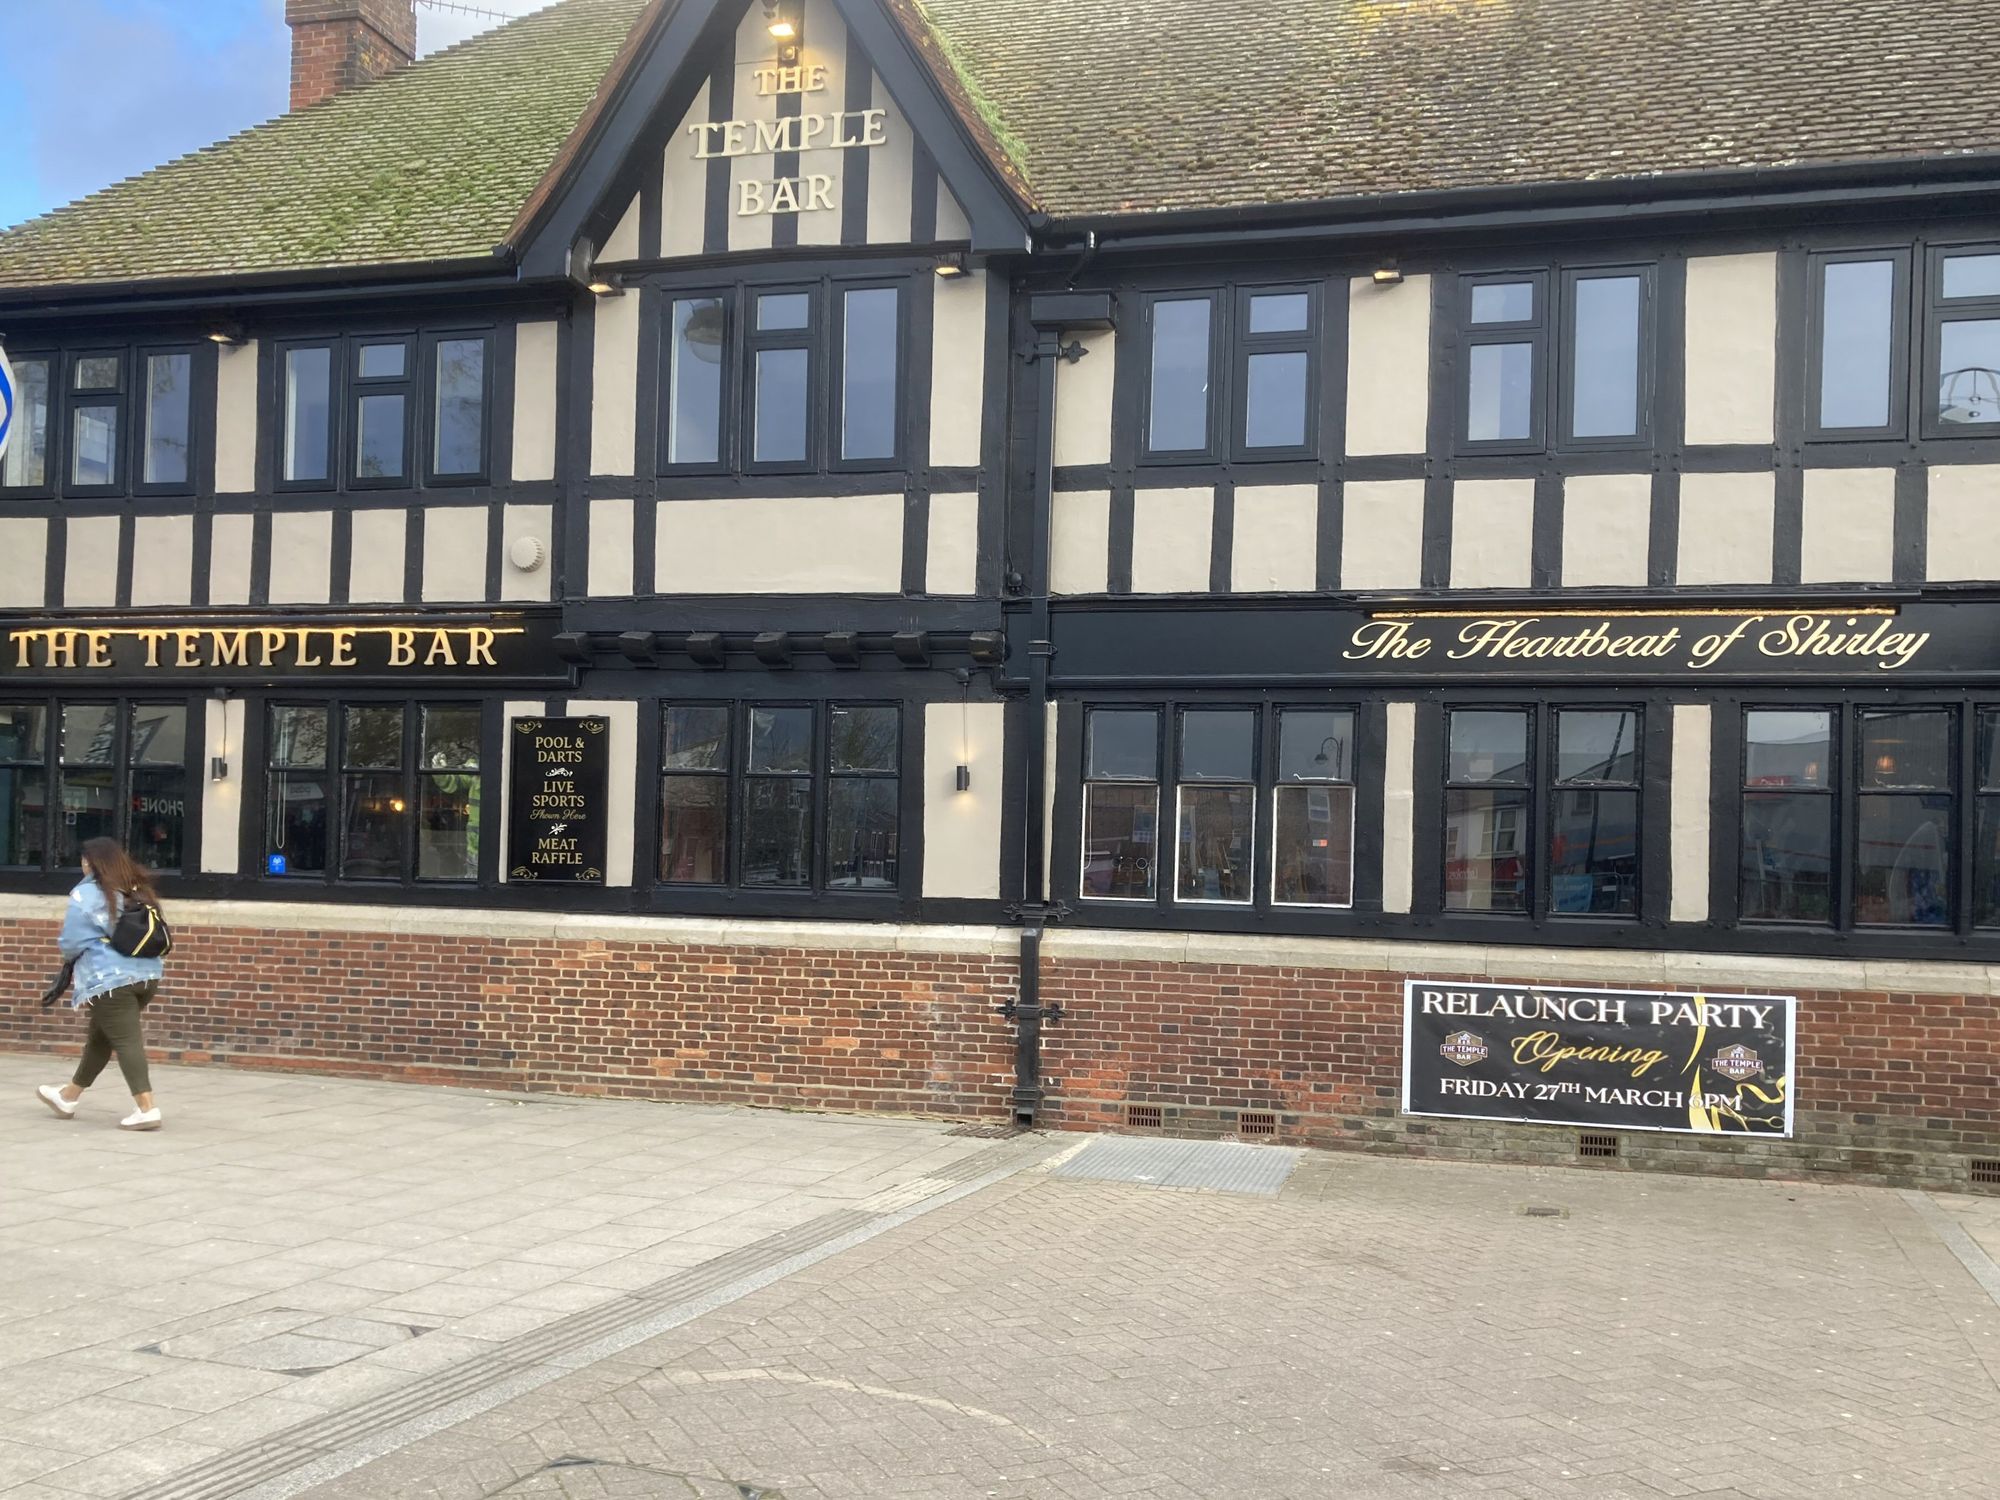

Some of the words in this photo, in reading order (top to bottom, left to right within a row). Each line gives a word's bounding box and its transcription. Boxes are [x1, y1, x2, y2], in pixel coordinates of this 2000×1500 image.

[753, 64, 825, 96] THE
[688, 108, 887, 158] TEMPLE
[737, 174, 836, 216] BAR
[9, 630, 112, 668] THE
[139, 628, 358, 668] TEMPLE
[387, 627, 498, 667] BAR
[1342, 619, 1432, 660] The
[1445, 617, 1682, 659] Heartbeat
[1687, 616, 1765, 670] of
[1757, 614, 1931, 670] Shirley
[535, 736, 572, 749] POOL
[575, 737, 585, 749] &
[537, 750, 583, 763] DARTS
[543, 781, 575, 793] LIVE
[532, 795, 585, 807] SPORTS
[562, 809, 587, 821] Here
[538, 838, 578, 850] MEAT
[531, 852, 583, 865] RAFFLE
[1421, 991, 1625, 1024] RELAUNCH
[1650, 999, 1774, 1029] PARTY
[1442, 1045, 1456, 1053] THE
[1457, 1045, 1487, 1055] TEMPLE
[1510, 1030, 1669, 1078] Opening
[1456, 1053, 1472, 1061] BAR
[1714, 1059, 1729, 1067] THE
[1729, 1059, 1761, 1069] TEMPLE
[1729, 1067, 1745, 1075] BAR
[1439, 1077, 1532, 1100] FRIDAY
[1534, 1081, 1581, 1102] 27TH
[1585, 1086, 1683, 1109] MARCH
[1688, 1092, 1743, 1112] 6PM
